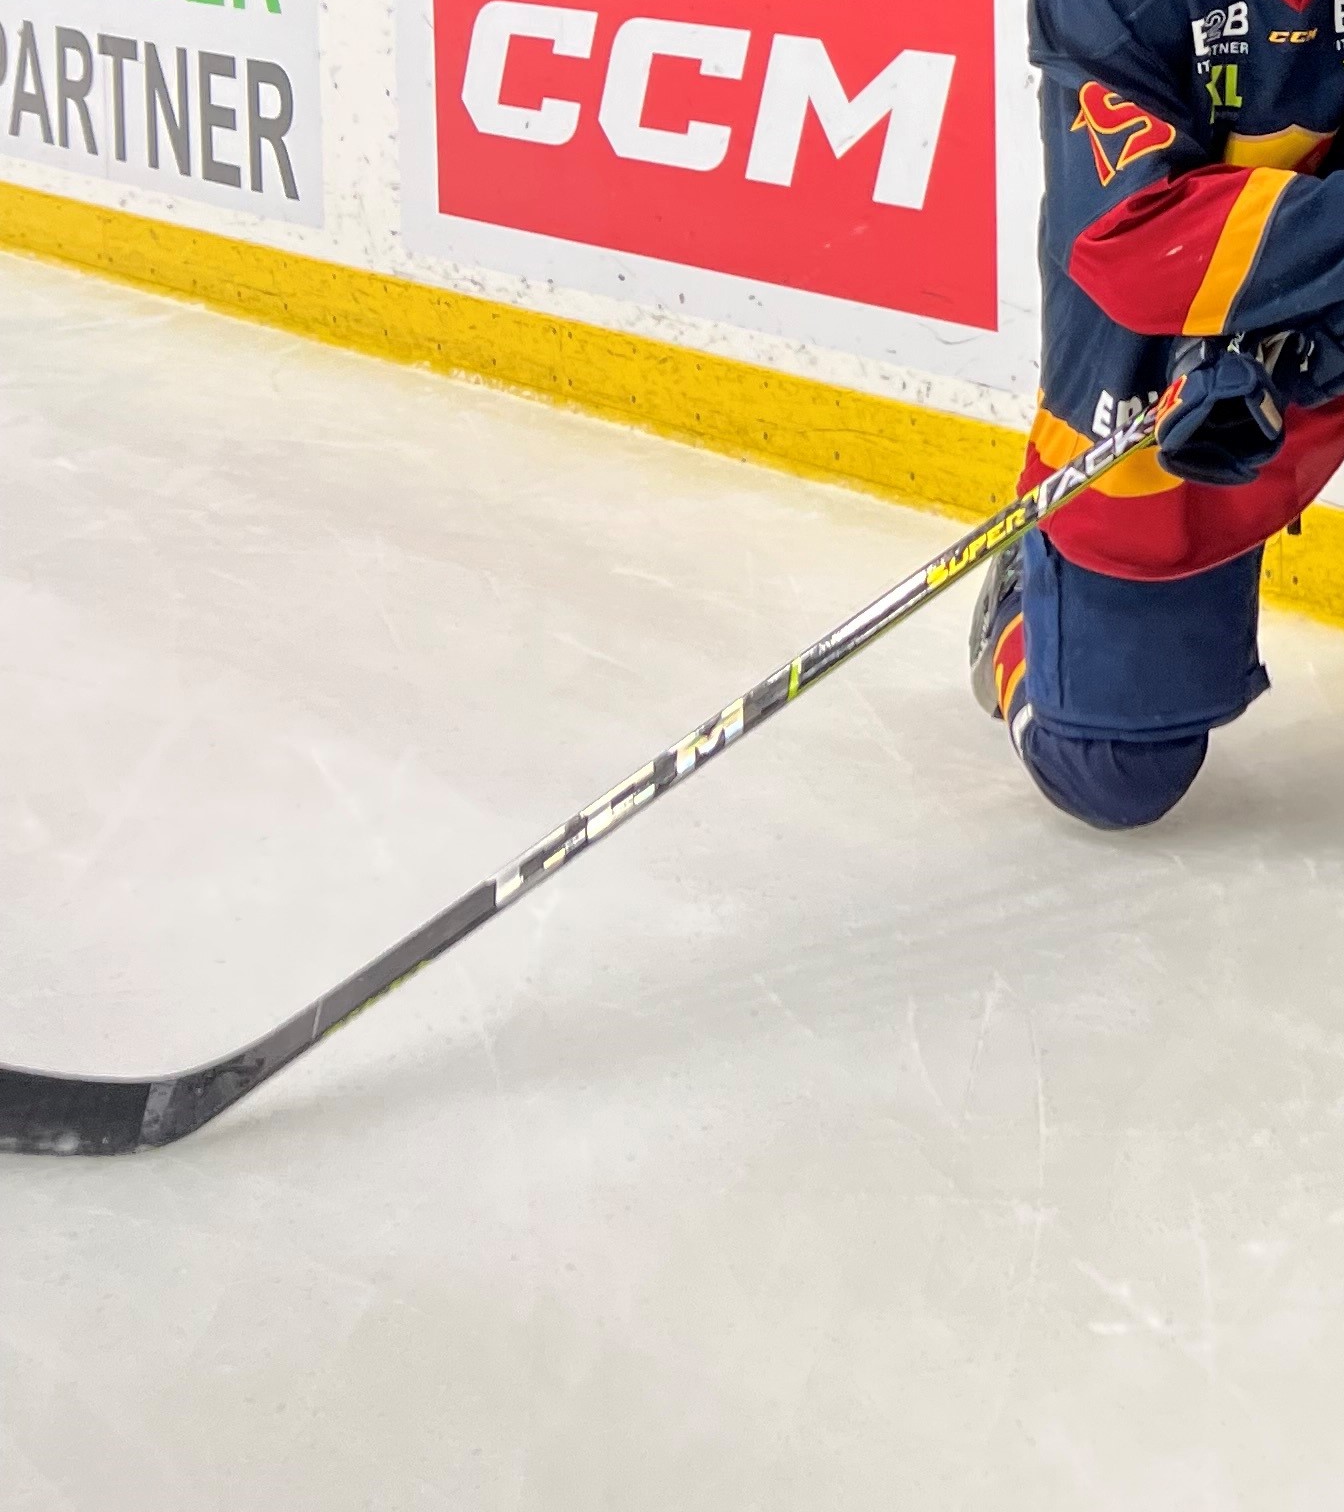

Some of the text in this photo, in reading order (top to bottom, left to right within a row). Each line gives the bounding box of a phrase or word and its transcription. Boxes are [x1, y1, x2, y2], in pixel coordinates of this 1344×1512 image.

[0, 19, 300, 201] ARTNER
[461, 0, 956, 210] CCM
[926, 506, 1027, 589] SUPER
